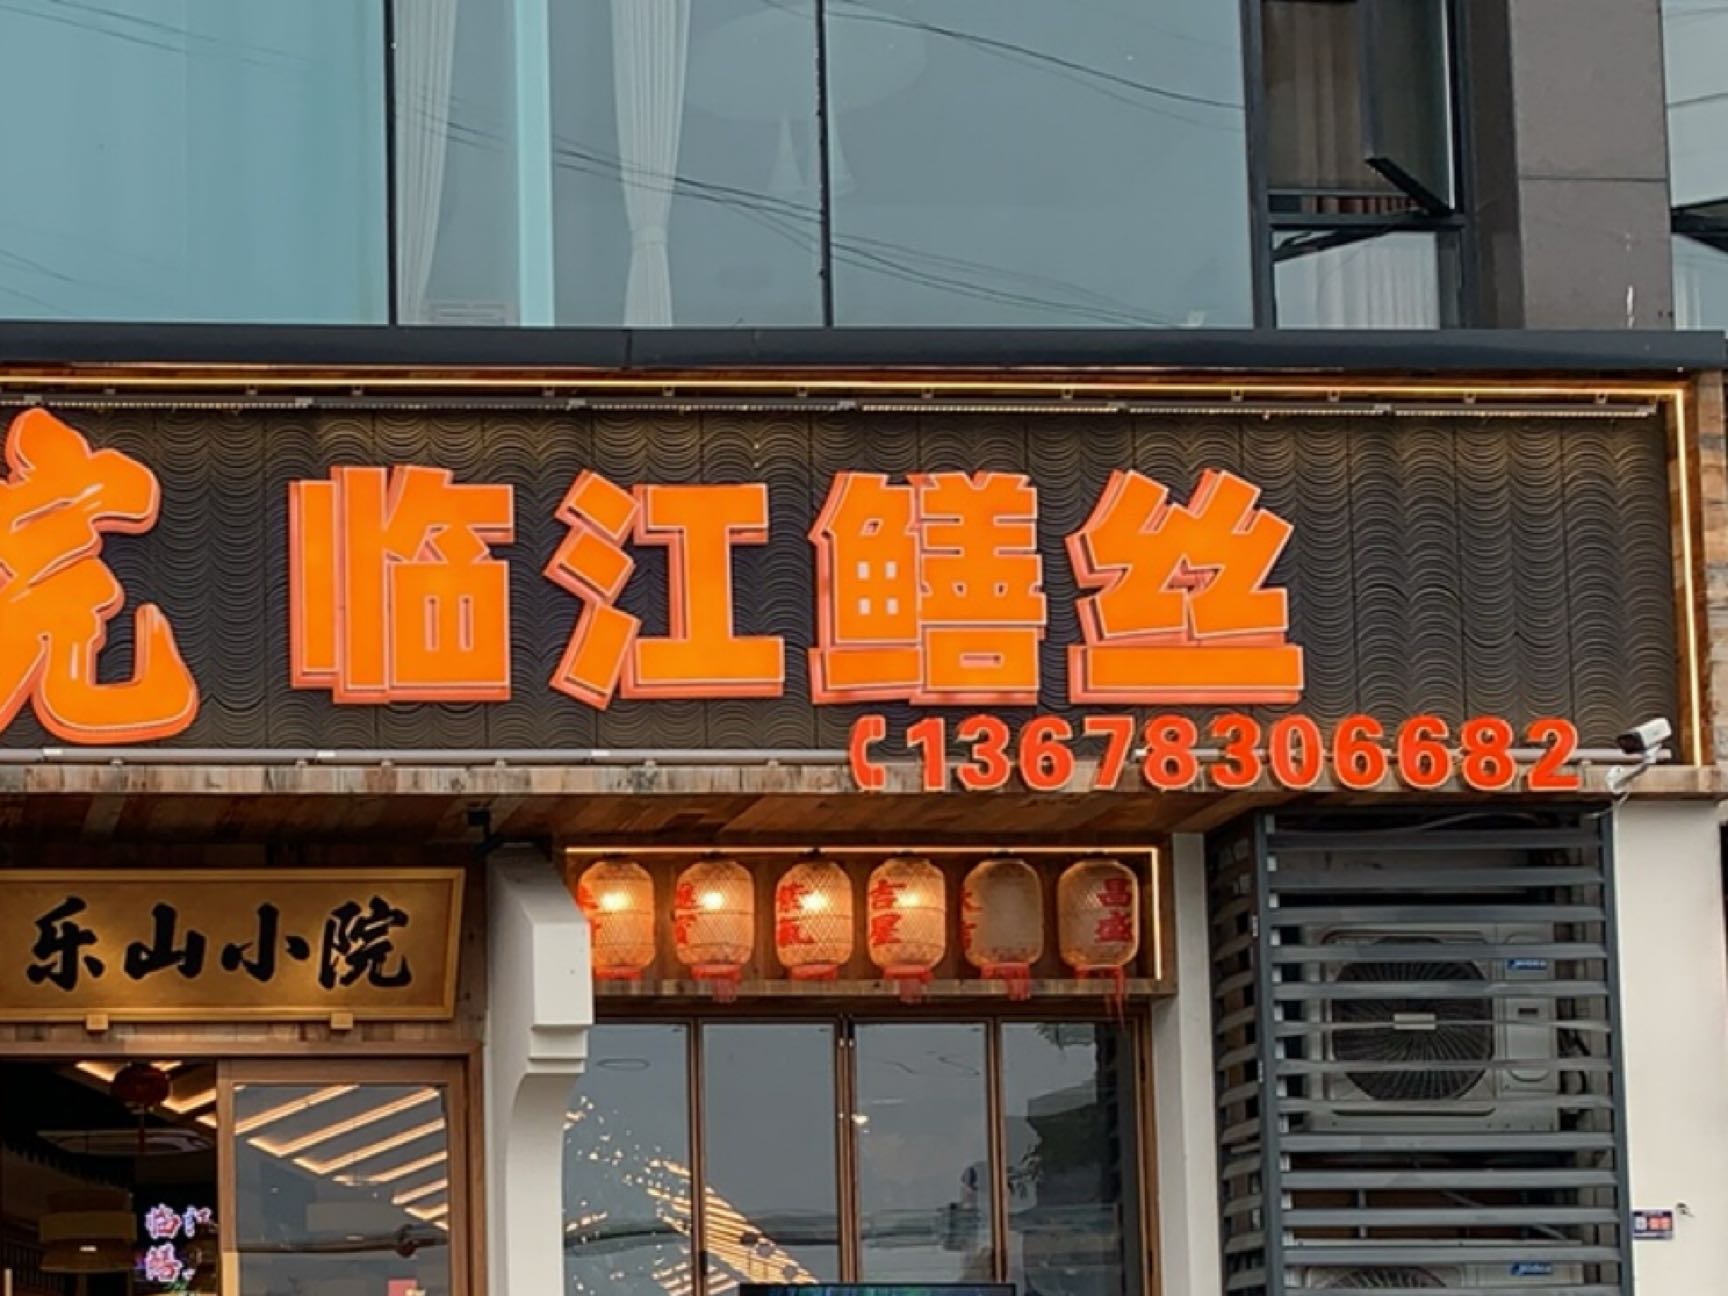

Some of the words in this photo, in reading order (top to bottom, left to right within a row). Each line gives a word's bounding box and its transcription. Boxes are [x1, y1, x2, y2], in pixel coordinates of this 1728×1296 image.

[288, 464, 1305, 709] 临江鳝丝
[904, 715, 1583, 794] 13678306682
[25, 895, 413, 992] 乐山小院
[1095, 878, 1133, 943] 昌盛
